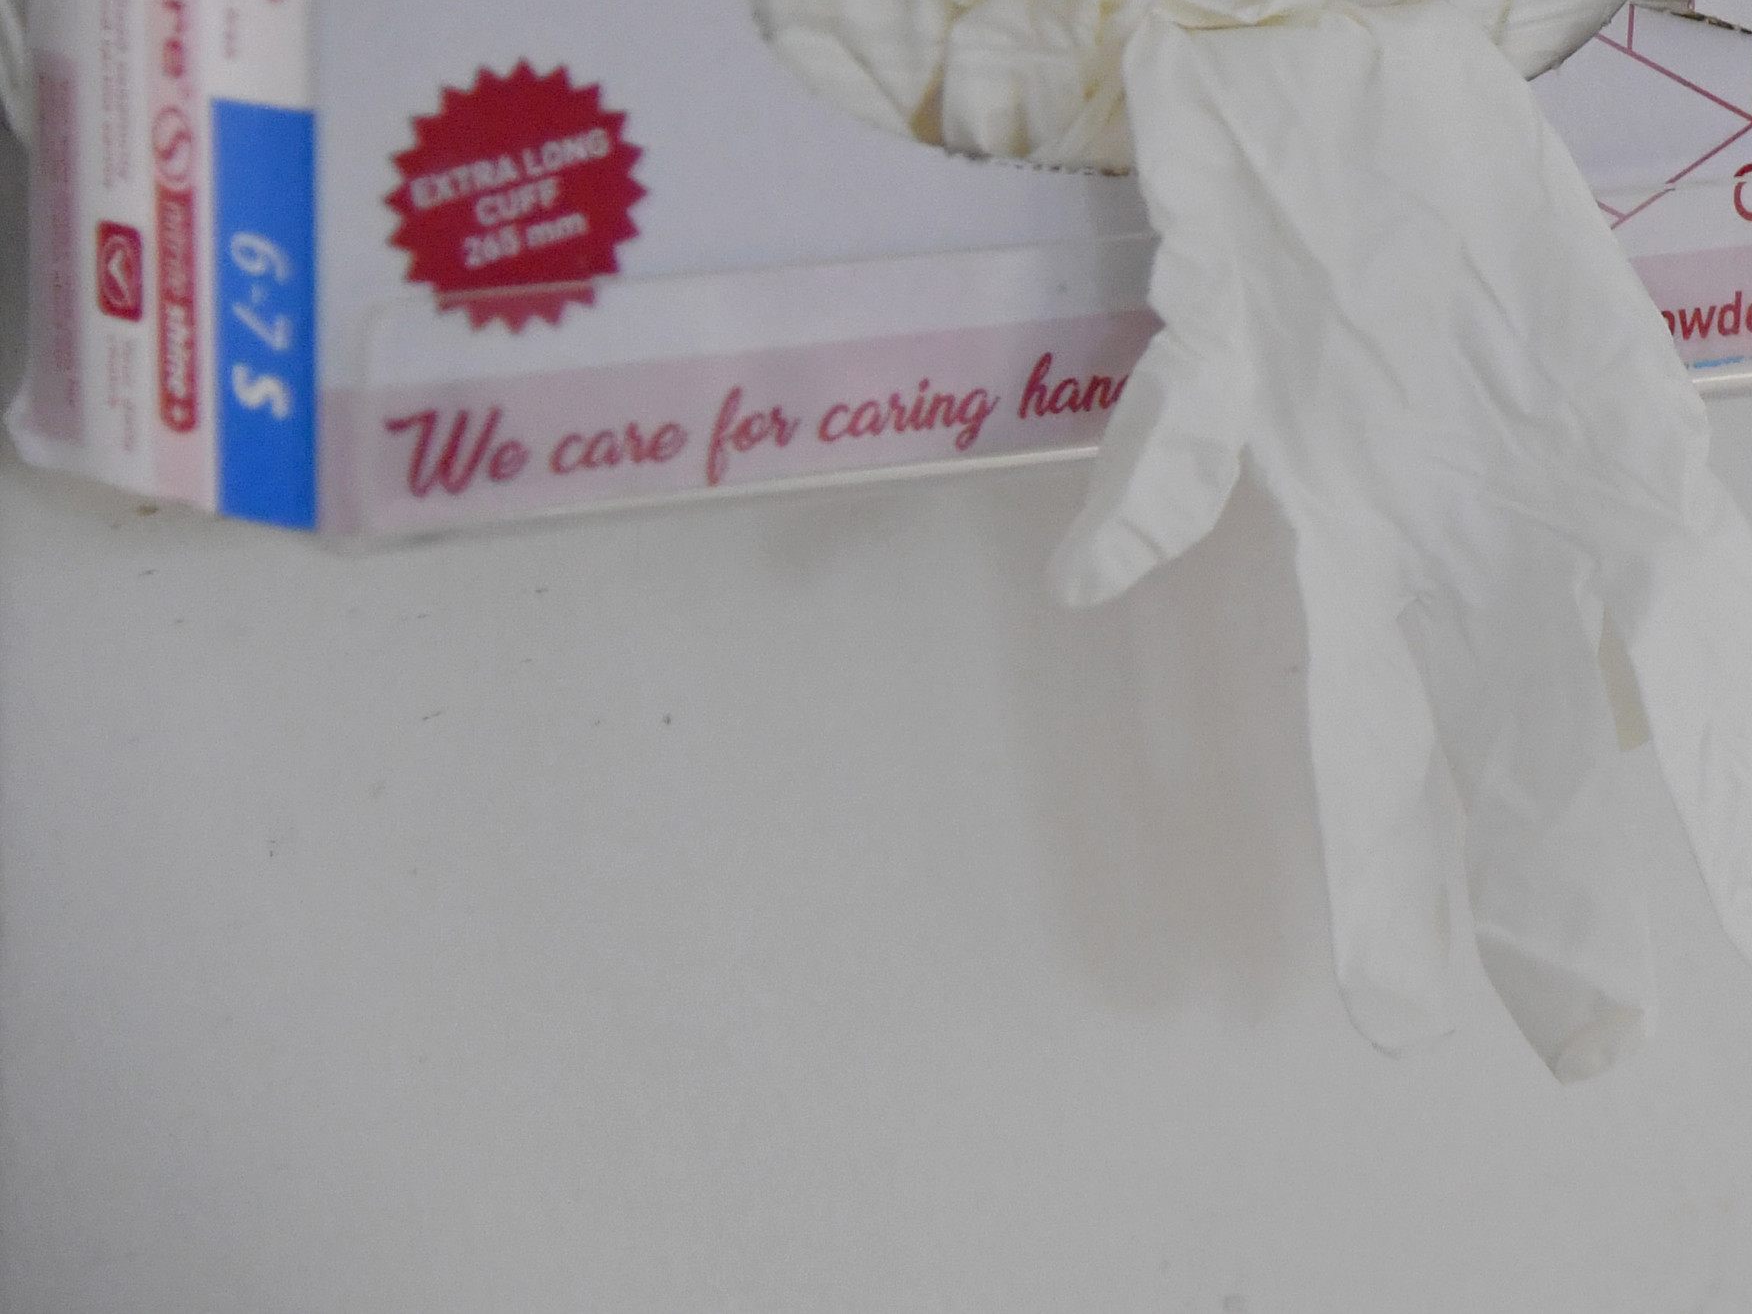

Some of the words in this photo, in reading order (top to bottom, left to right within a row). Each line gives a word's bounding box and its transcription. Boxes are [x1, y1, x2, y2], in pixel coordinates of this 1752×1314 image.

[409, 152, 519, 211] EXTRA
[521, 127, 610, 177] LONG
[475, 176, 558, 226] CUFF
[525, 212, 589, 249] mm
[383, 406, 530, 499] We
[548, 419, 689, 476] care
[704, 385, 800, 488] for
[816, 377, 1000, 451] caring
[1018, 351, 1129, 420] han
